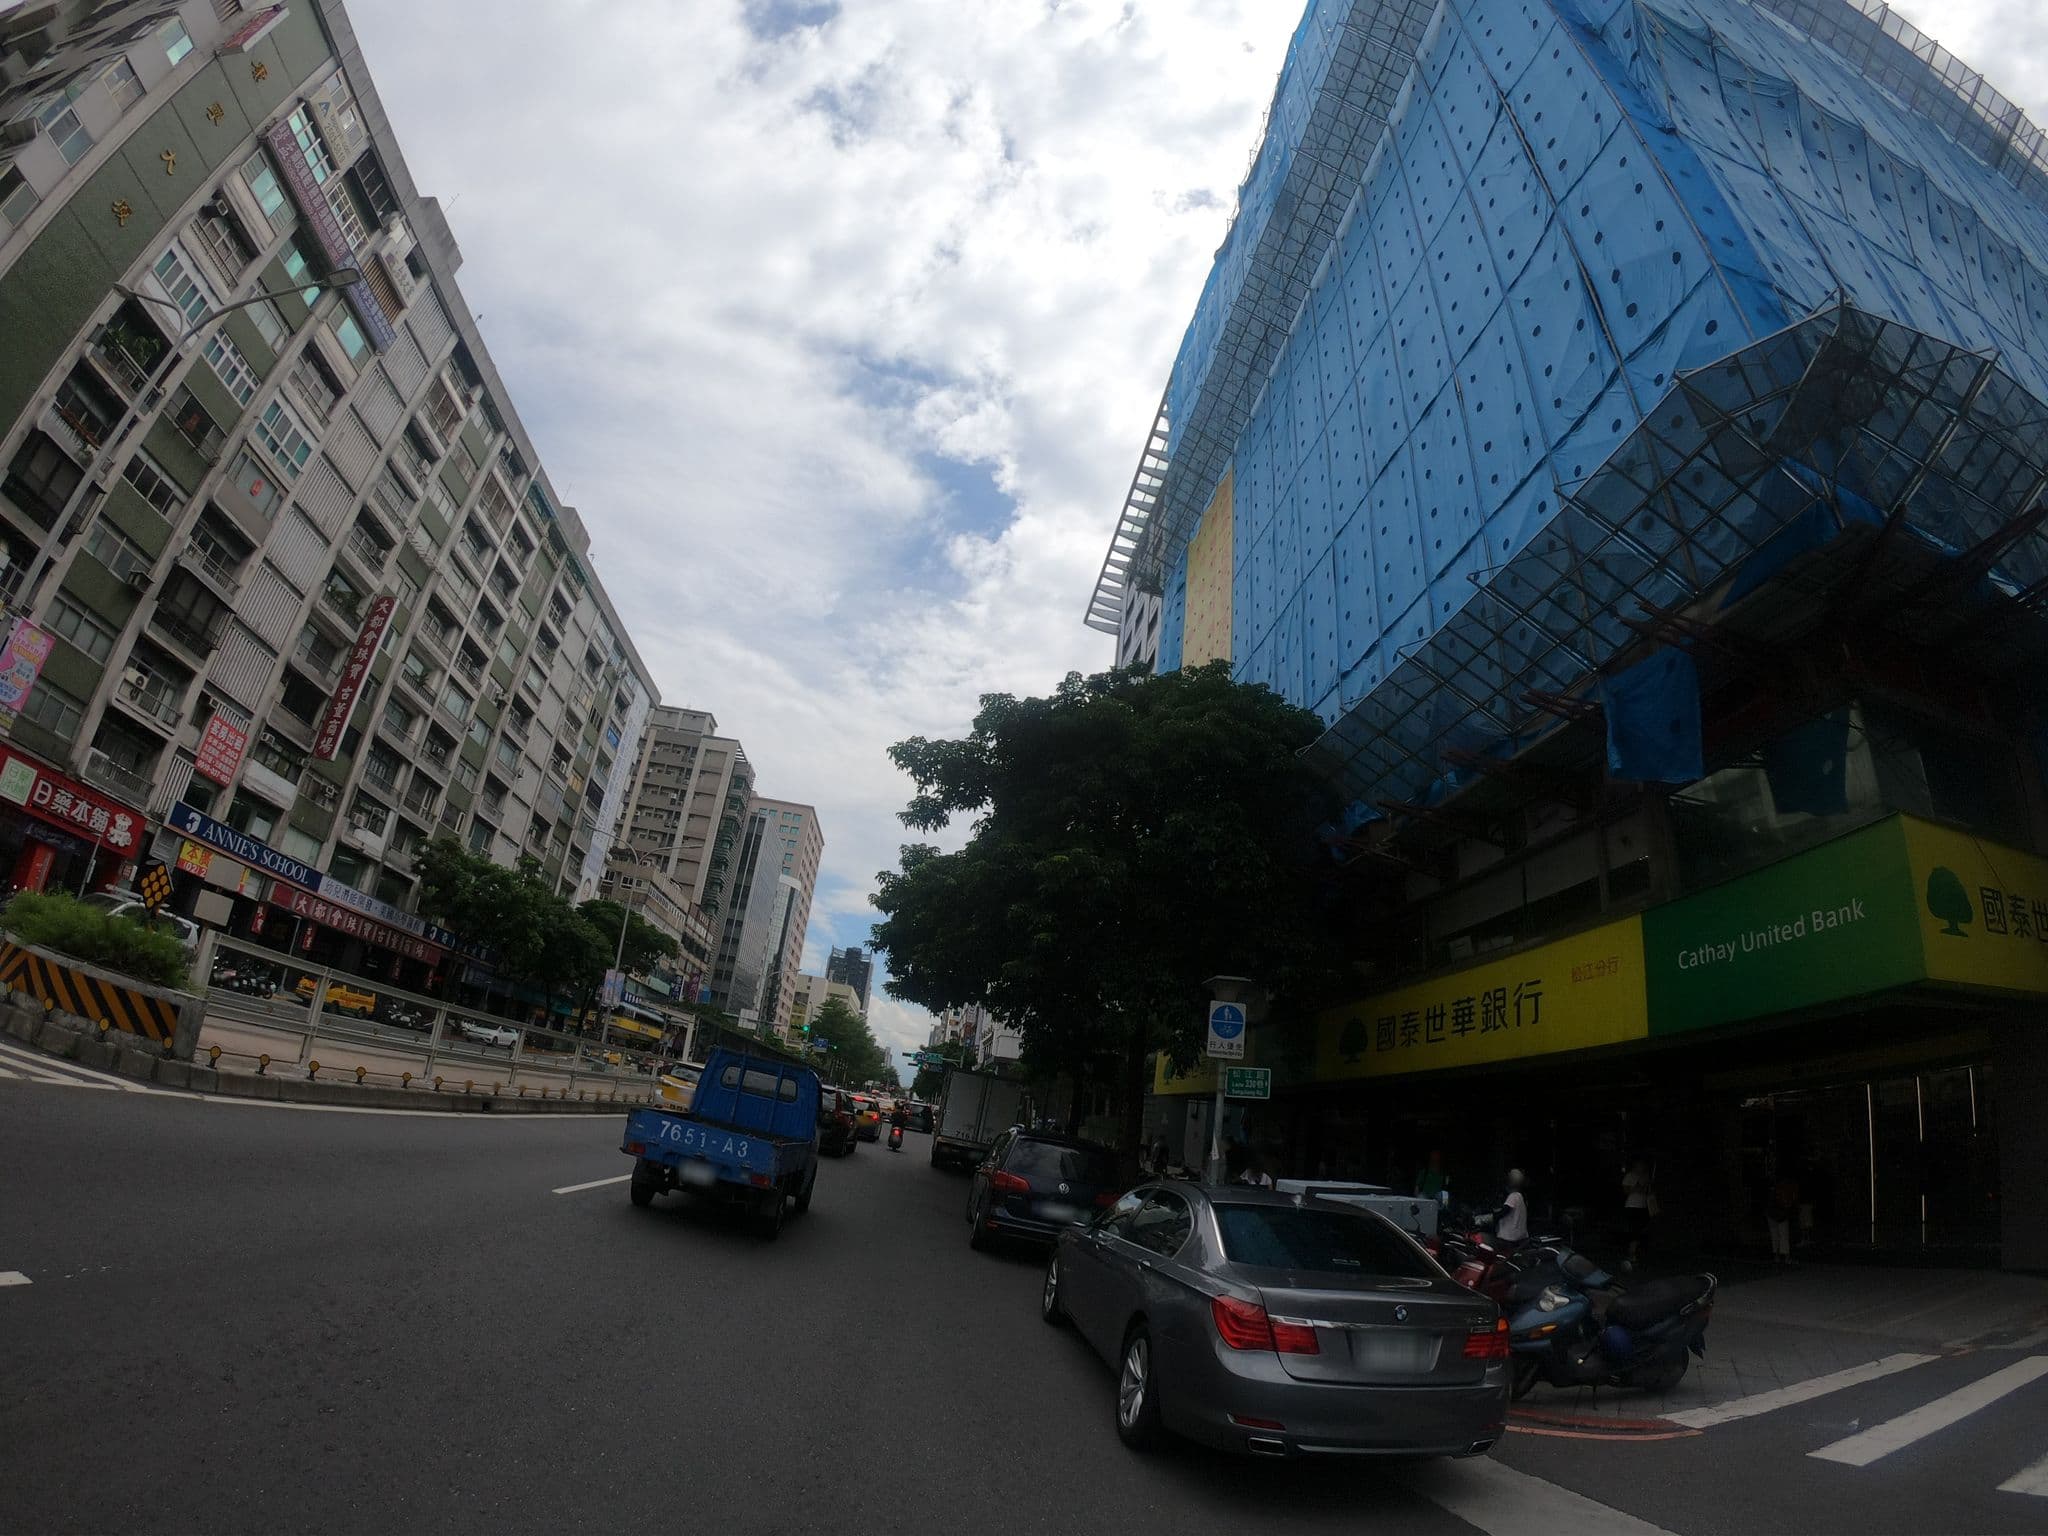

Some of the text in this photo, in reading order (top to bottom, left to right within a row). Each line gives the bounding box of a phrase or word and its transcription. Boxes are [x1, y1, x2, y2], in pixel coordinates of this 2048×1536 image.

[32, 778, 110, 835] 日藥本舖
[202, 822, 259, 861] ANNIE'S
[260, 848, 309, 885] SCHOOL
[297, 895, 424, 960] 大都會珠寶古董商場
[1678, 897, 1867, 970] Cathay United Bank
[1376, 978, 1544, 1053] 國泰世華銀行
[1232, 1069, 1265, 1080] 松江路
